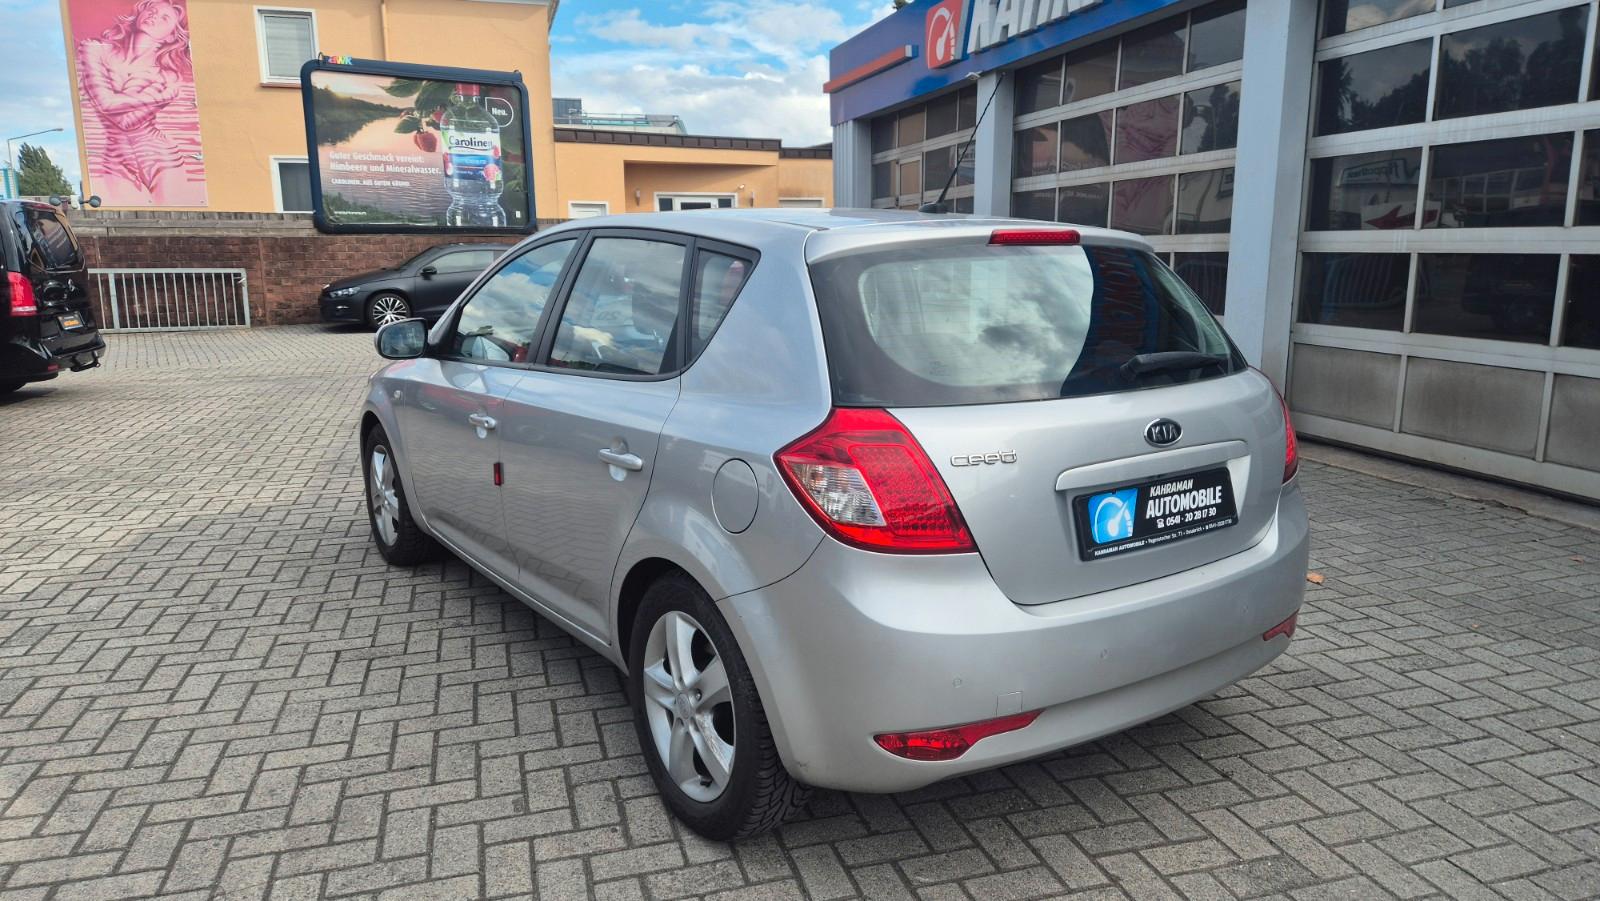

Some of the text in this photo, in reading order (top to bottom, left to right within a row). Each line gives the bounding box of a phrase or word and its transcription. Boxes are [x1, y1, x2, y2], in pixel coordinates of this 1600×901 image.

[491, 107, 508, 116] Neu.
[449, 136, 492, 148] Carolinen
[329, 151, 351, 161] Guter
[353, 152, 396, 163] Geschmack
[330, 162, 442, 175] Himbeere und Mineralwasser.
[1151, 424, 1178, 441] KIA
[1149, 479, 1194, 497] KAHRAMAN
[1146, 485, 1222, 519] AUTOMOBILE
[1166, 515, 1181, 527] 0541
[1184, 513, 1193, 523] 20
[1193, 511, 1202, 521] 28
[1208, 507, 1217, 517] 30
[1094, 545, 1119, 556] KAHRAMAN
[1119, 540, 1145, 551] AUTOMOBILE
